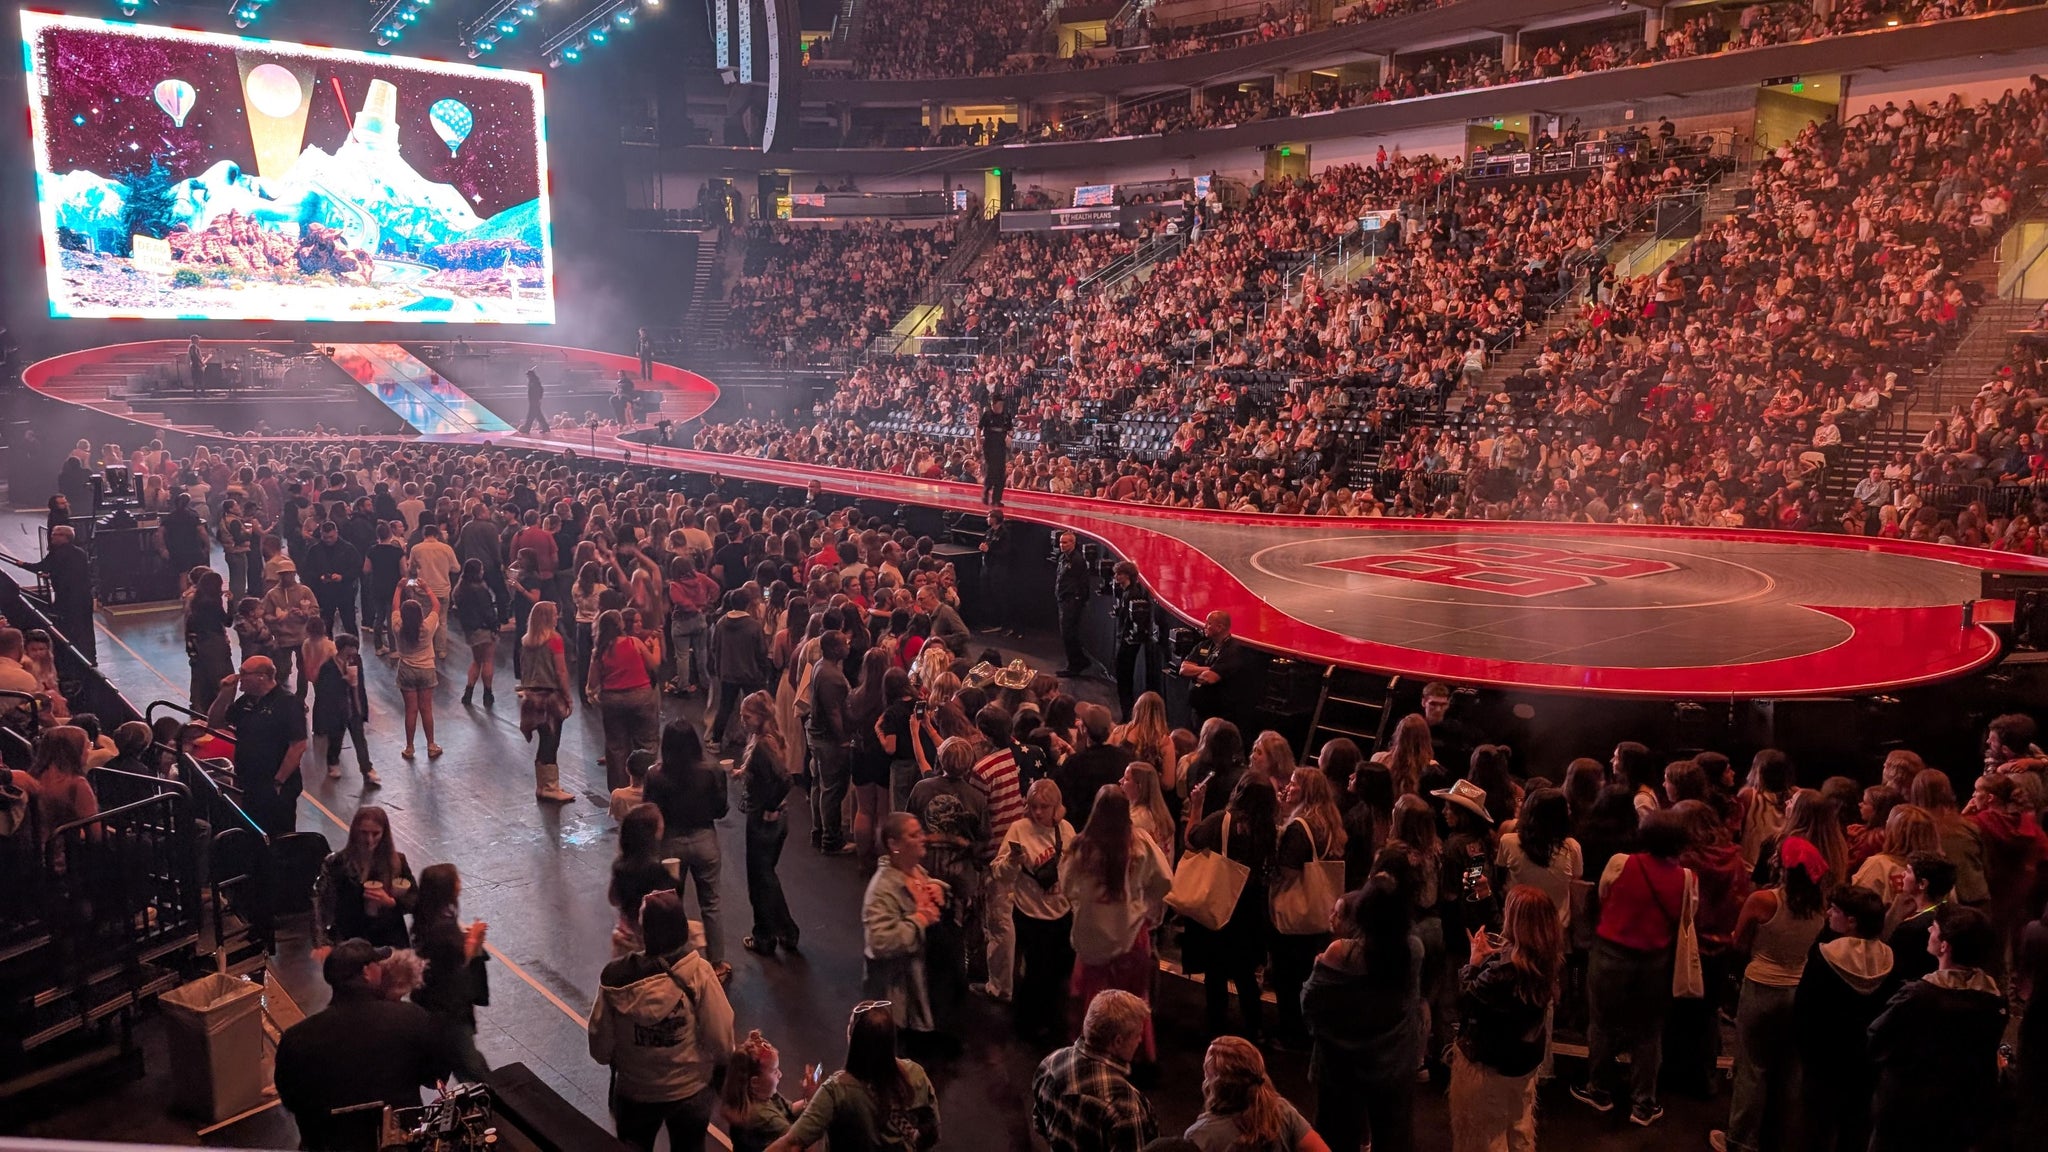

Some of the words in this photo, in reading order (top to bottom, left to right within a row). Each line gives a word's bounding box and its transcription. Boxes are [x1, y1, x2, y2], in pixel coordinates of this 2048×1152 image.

[40, 76, 49, 96] MADE
[1070, 213, 1093, 221] HEALTH
[1093, 211, 1112, 220] PLANS
[138, 240, 167, 254] DEAD
[143, 255, 165, 267] END
